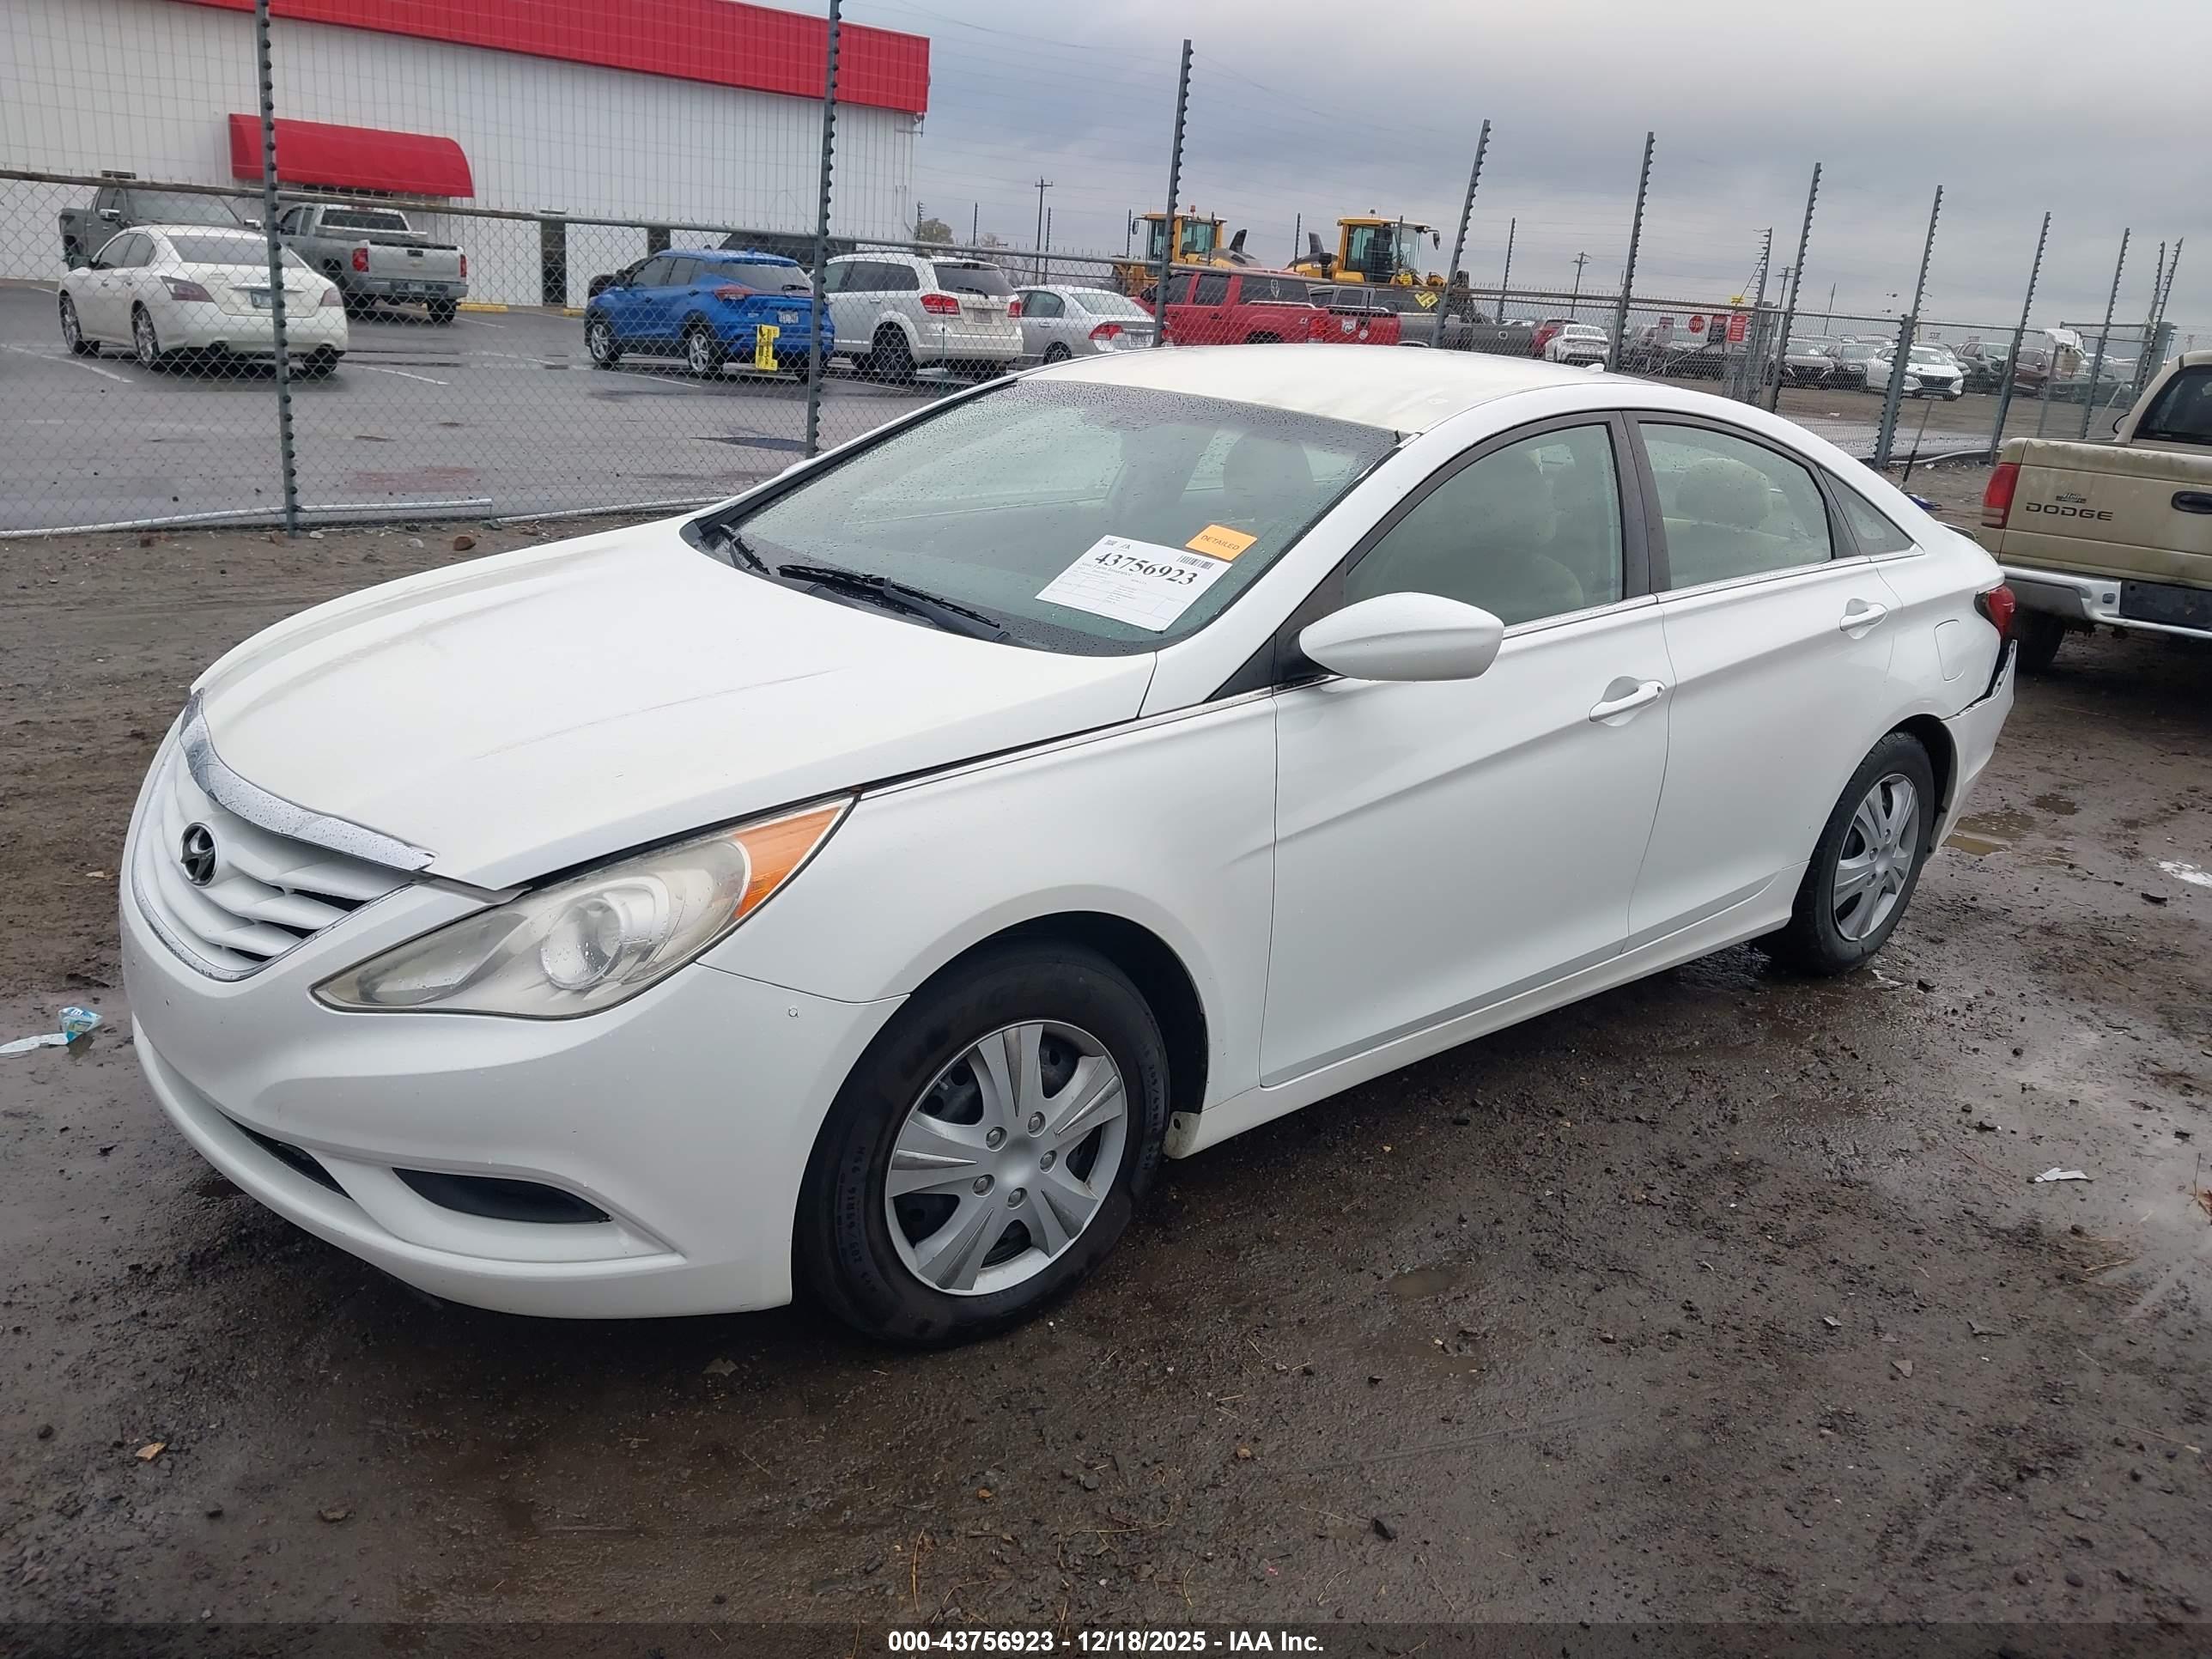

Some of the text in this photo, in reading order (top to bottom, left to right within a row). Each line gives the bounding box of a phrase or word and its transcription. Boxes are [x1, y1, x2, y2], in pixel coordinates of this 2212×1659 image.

[1689, 320, 1704, 329] STOP
[2026, 502, 2113, 521] DODGE
[1200, 535, 1240, 550] DETAILED
[1094, 551, 1199, 586] 43756923
